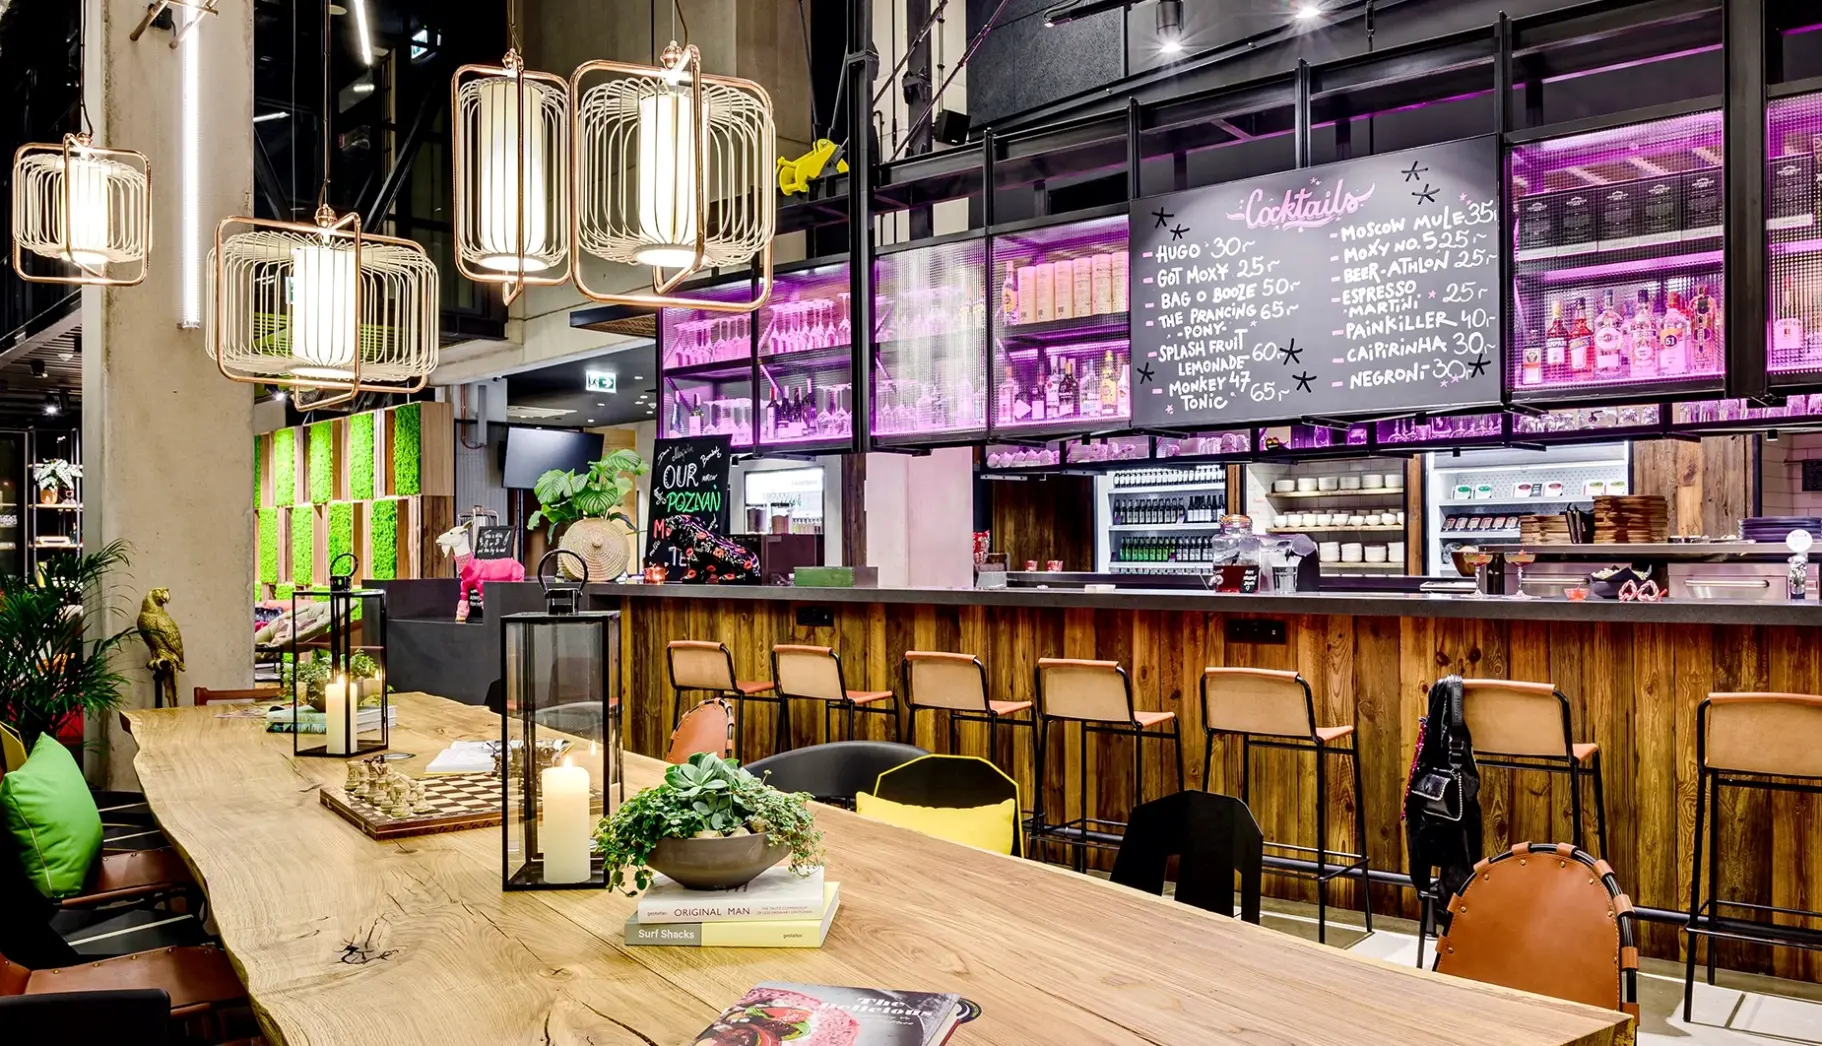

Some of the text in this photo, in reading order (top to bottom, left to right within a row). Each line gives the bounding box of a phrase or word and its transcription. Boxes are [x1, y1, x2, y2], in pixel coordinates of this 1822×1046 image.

[1245, 179, 1375, 229] Cocktails
[1341, 217, 1406, 242] MOSCOW
[1413, 205, 1465, 231] MULE
[1422, 231, 1438, 250] 5
[1156, 243, 1201, 263] HUGO
[1157, 267, 1184, 288] GOT
[1187, 262, 1229, 284] MOXY
[1343, 249, 1450, 284] BEER-ATHLON
[1161, 291, 1191, 309] BAG
[1196, 290, 1207, 302] O
[1212, 283, 1257, 303] BOOZE
[1342, 280, 1417, 305] ESPRESSO
[1158, 311, 1183, 329] THE
[1158, 340, 1206, 362] SPLASH
[1178, 354, 1250, 377] LEMONADE
[1169, 370, 1251, 397] MONKEY 47
[663, 463, 699, 489] OUR
[673, 908, 722, 917] ORIGINAL
[727, 907, 751, 916] MAN
[638, 929, 695, 939] Surf Shacks
[857, 997, 905, 1007] The
